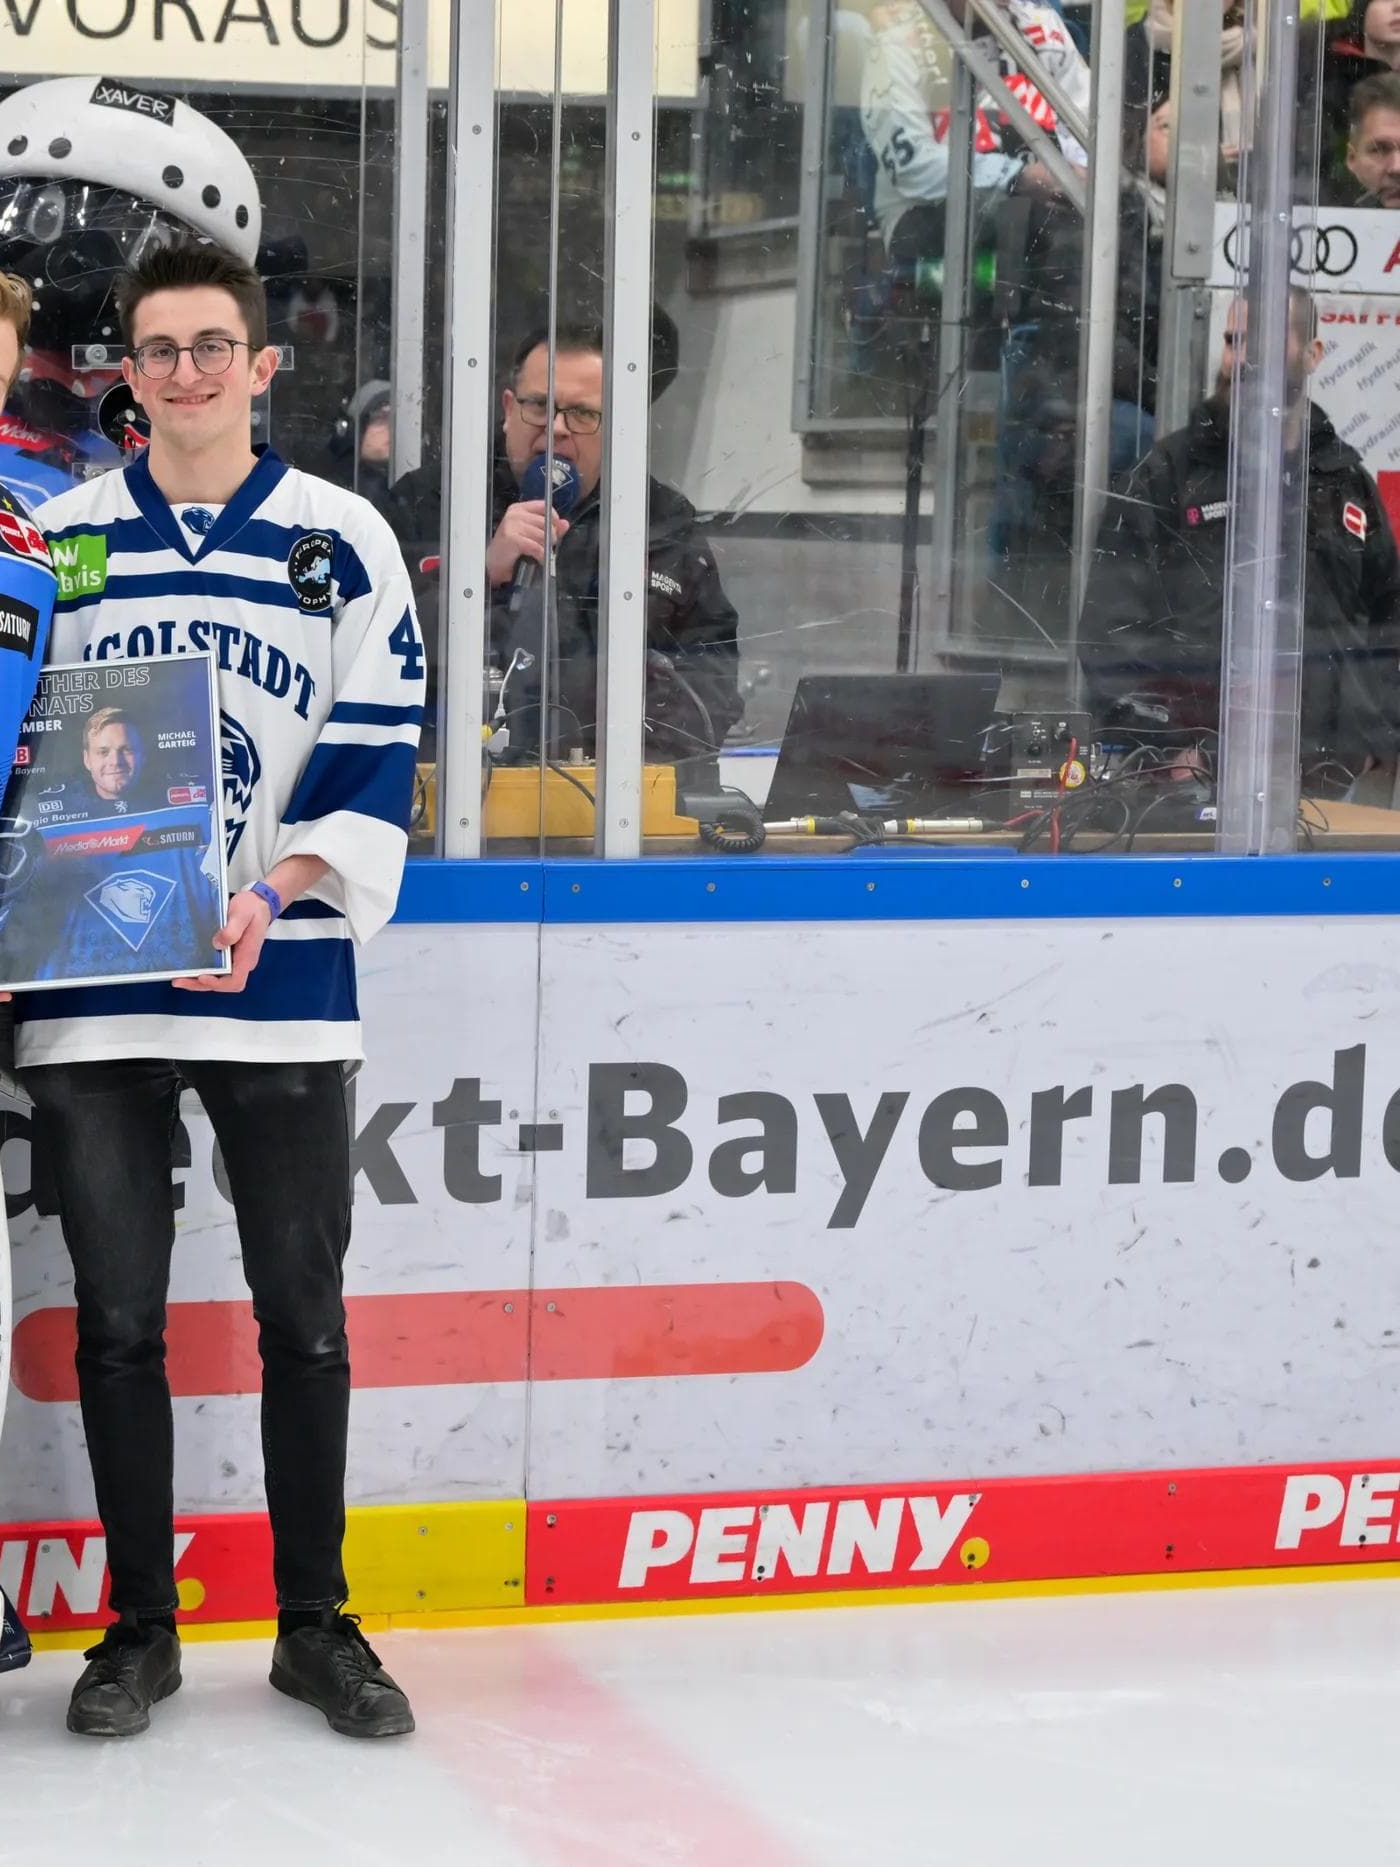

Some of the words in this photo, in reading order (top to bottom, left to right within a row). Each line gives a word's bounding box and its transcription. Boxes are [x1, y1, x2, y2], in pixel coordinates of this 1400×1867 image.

[96, 84, 170, 118] XAVER
[650, 578, 674, 596] SPORT
[651, 571, 682, 595] MAGENTA
[36, 671, 101, 695] THER
[106, 666, 151, 689] DES
[28, 693, 94, 718] NATS
[157, 730, 197, 741] MICHAEL
[158, 738, 197, 750] GARTEIG
[31, 814, 49, 828] gio
[51, 811, 89, 823] Bayern
[159, 831, 195, 845] SATURN
